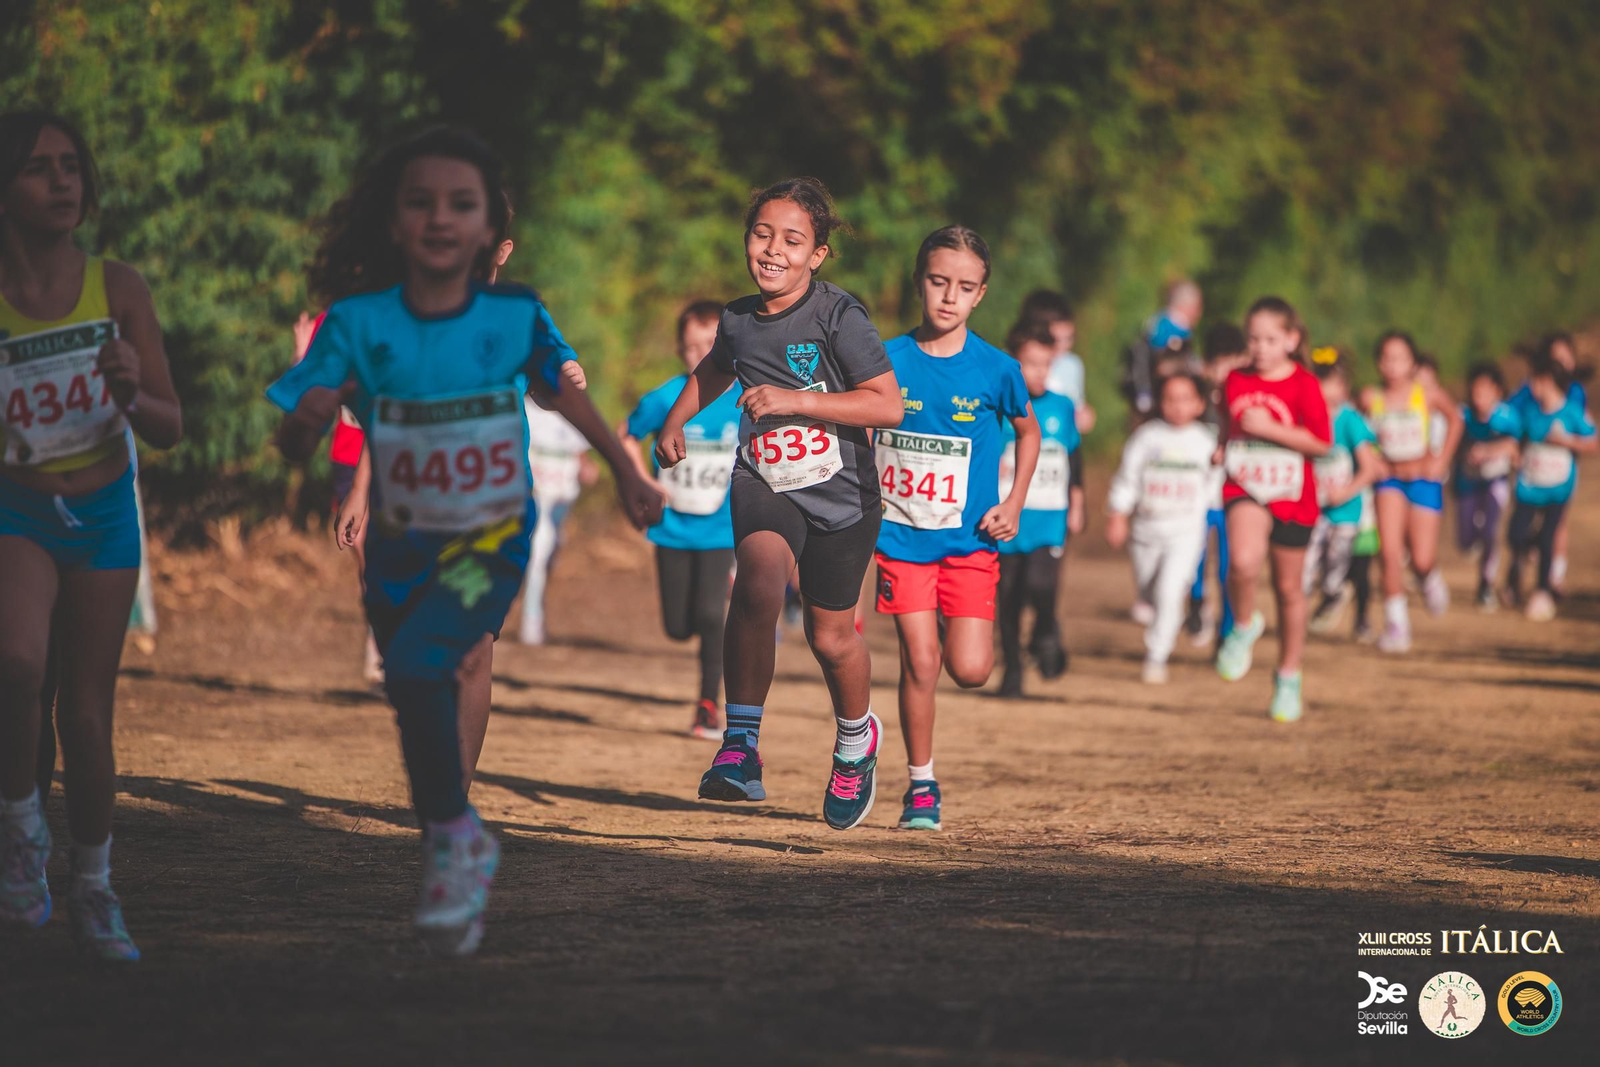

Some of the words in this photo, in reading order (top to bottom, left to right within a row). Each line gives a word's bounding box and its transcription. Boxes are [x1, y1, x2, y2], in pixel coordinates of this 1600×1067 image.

[748, 423, 831, 465] 4533
[896, 435, 944, 453] ITÁLICA
[389, 439, 517, 494] 4495
[881, 464, 958, 504] 4341
